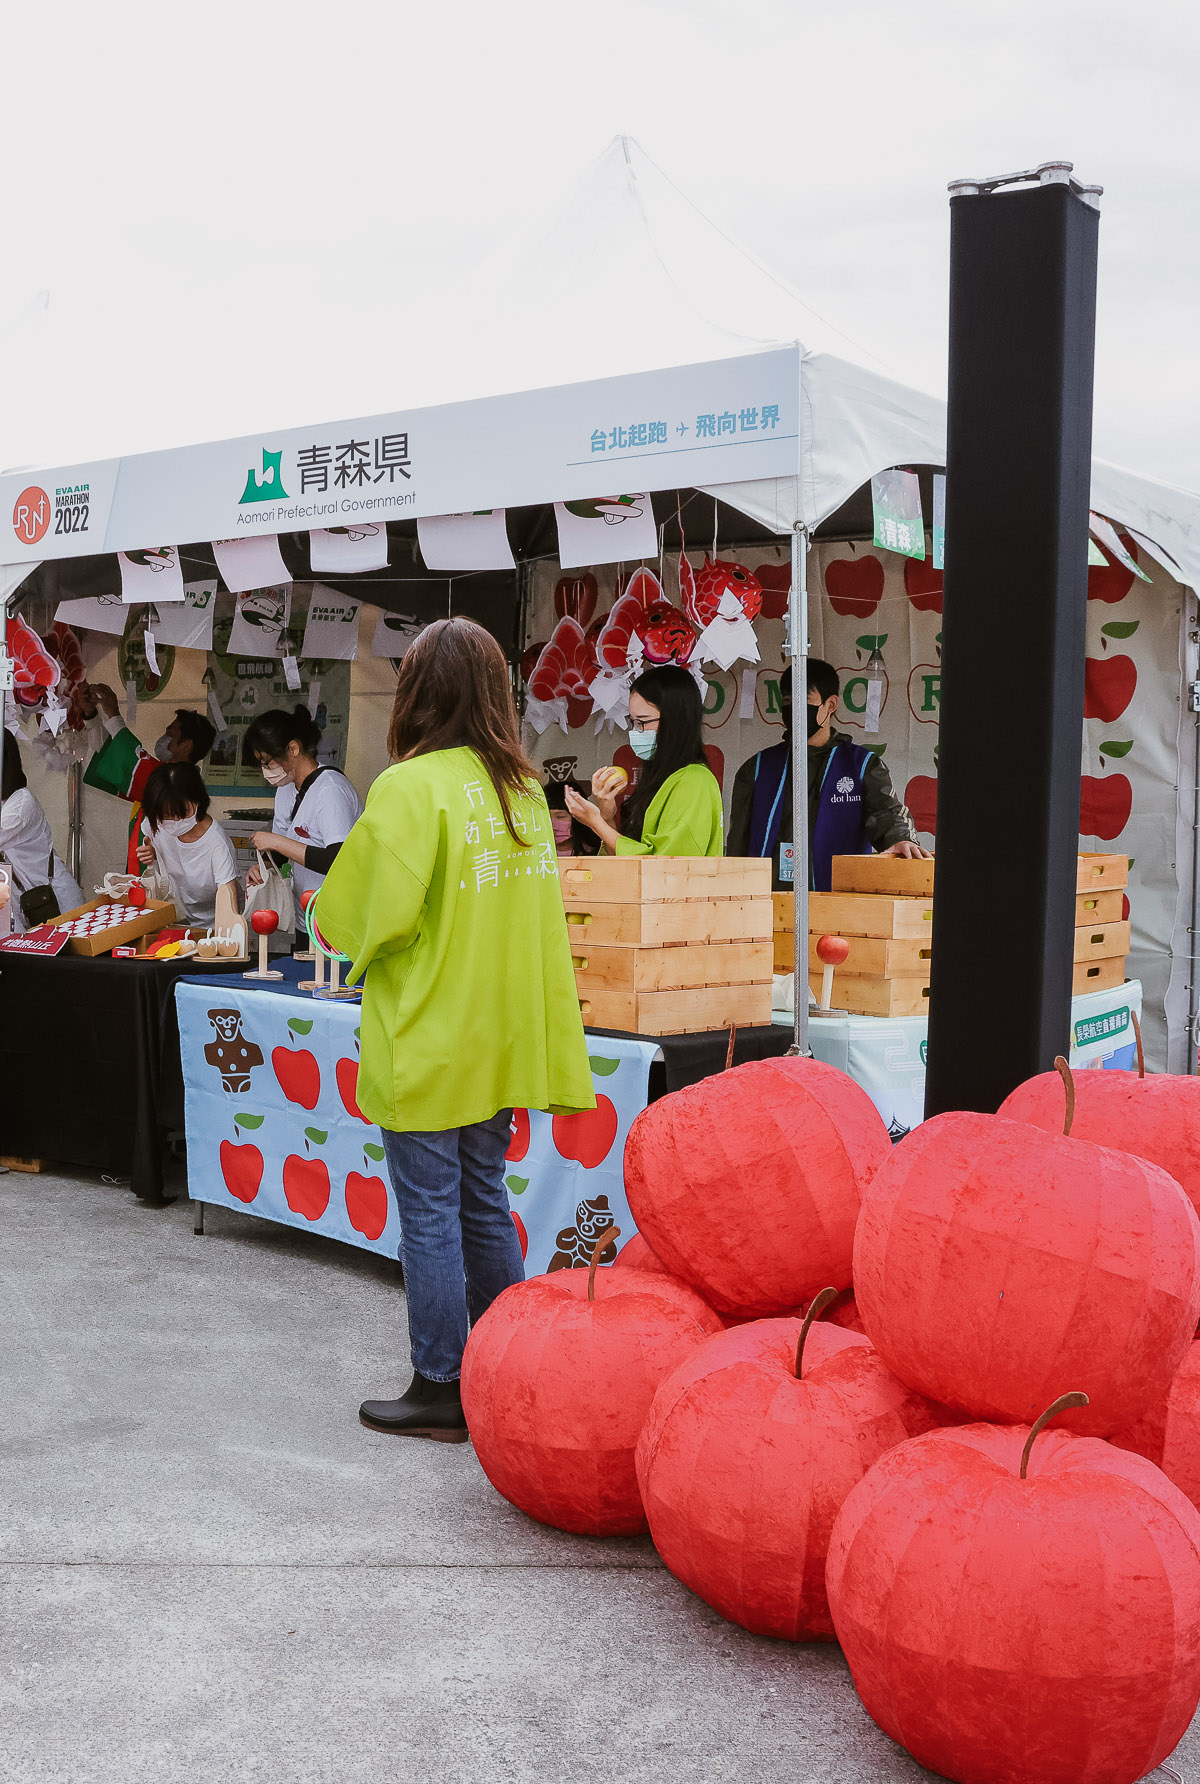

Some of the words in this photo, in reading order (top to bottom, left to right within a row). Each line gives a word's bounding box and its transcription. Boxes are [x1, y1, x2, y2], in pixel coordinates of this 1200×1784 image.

[590, 421, 667, 452] 台北起跑
[696, 405, 780, 438] 飛向世界
[297, 433, 412, 494] 青森県
[55, 487, 73, 495] EVA
[74, 484, 90, 493] AIR
[55, 492, 90, 508] MARATHON
[237, 508, 275, 525] Aomori
[277, 500, 339, 520] Prefectural
[341, 491, 416, 512] Government
[55, 505, 90, 535] 2022
[328, 607, 345, 615] AIR
[830, 794, 844, 803] dot
[846, 793, 861, 802] han
